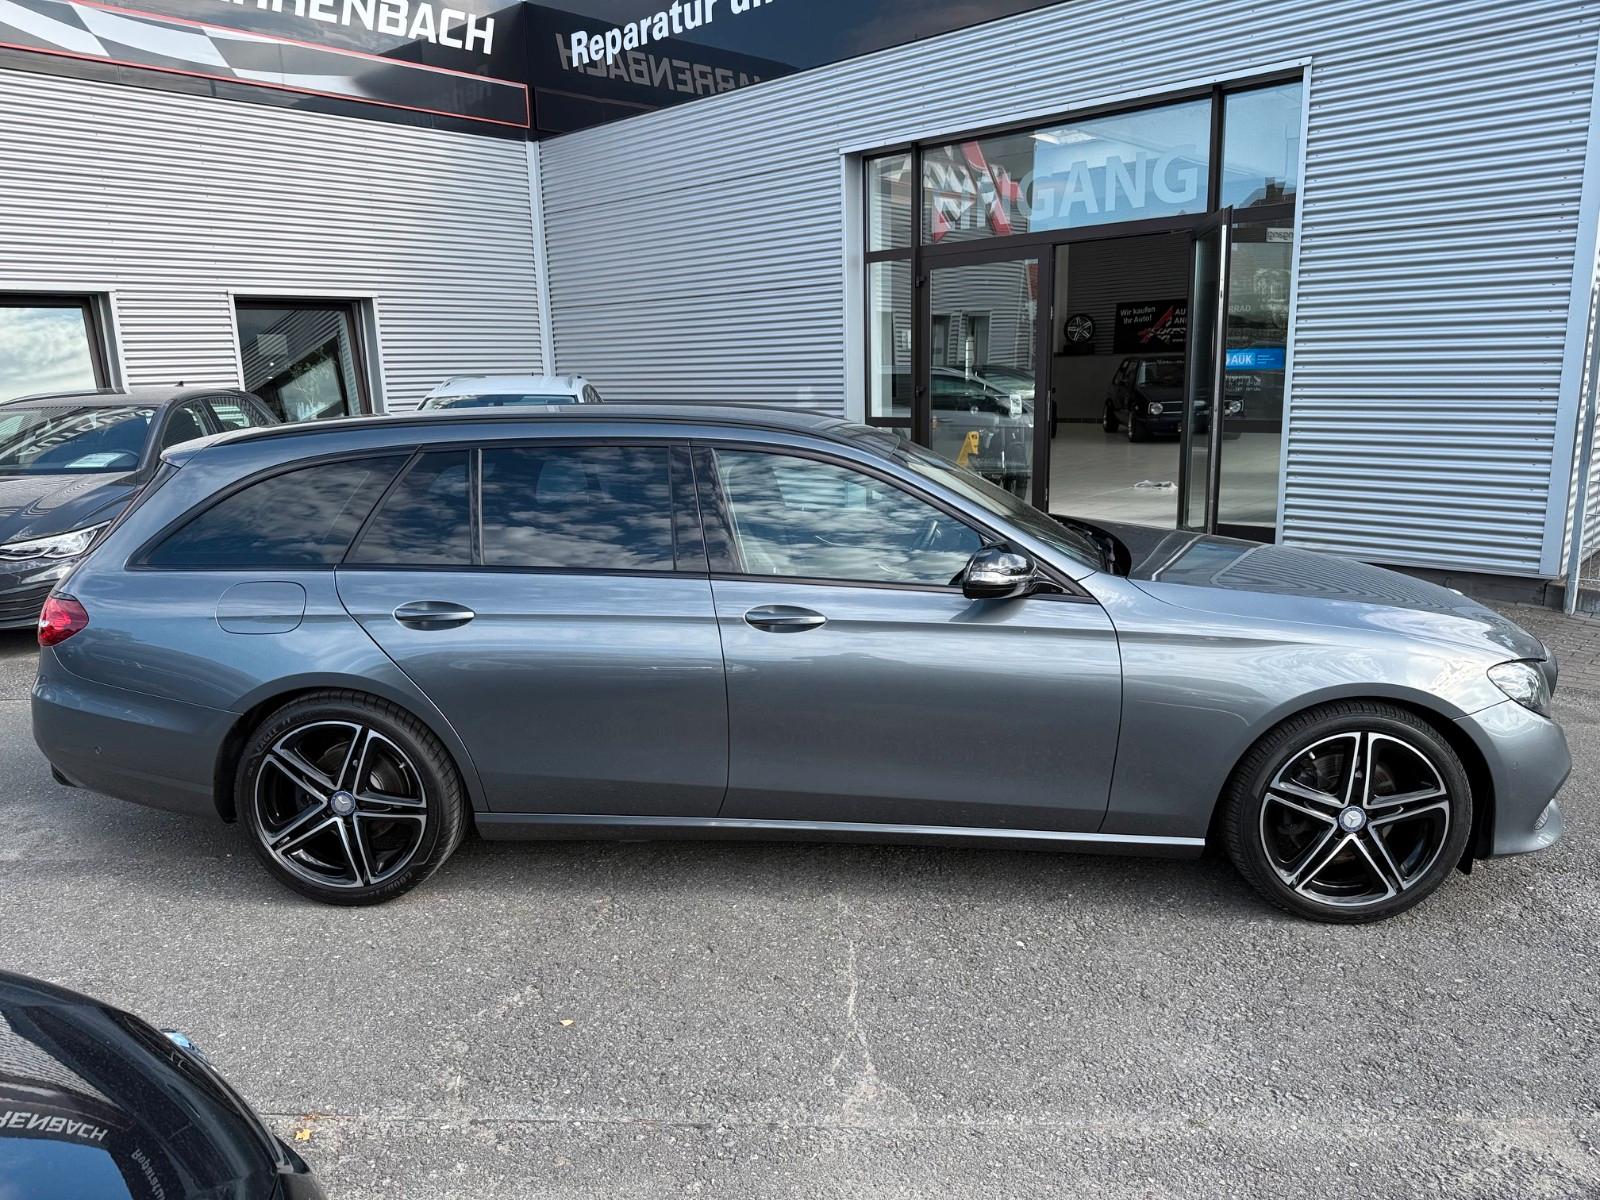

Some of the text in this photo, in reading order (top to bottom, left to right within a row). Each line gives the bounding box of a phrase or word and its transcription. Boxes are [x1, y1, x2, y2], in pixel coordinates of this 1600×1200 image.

[219, 0, 494, 54] ENBACH
[570, 0, 719, 67] Reparatur
[931, 143, 1199, 232] EINGANG
[1120, 306, 1156, 316] Wir kaufen
[1123, 313, 1152, 325] Ihr Auto!
